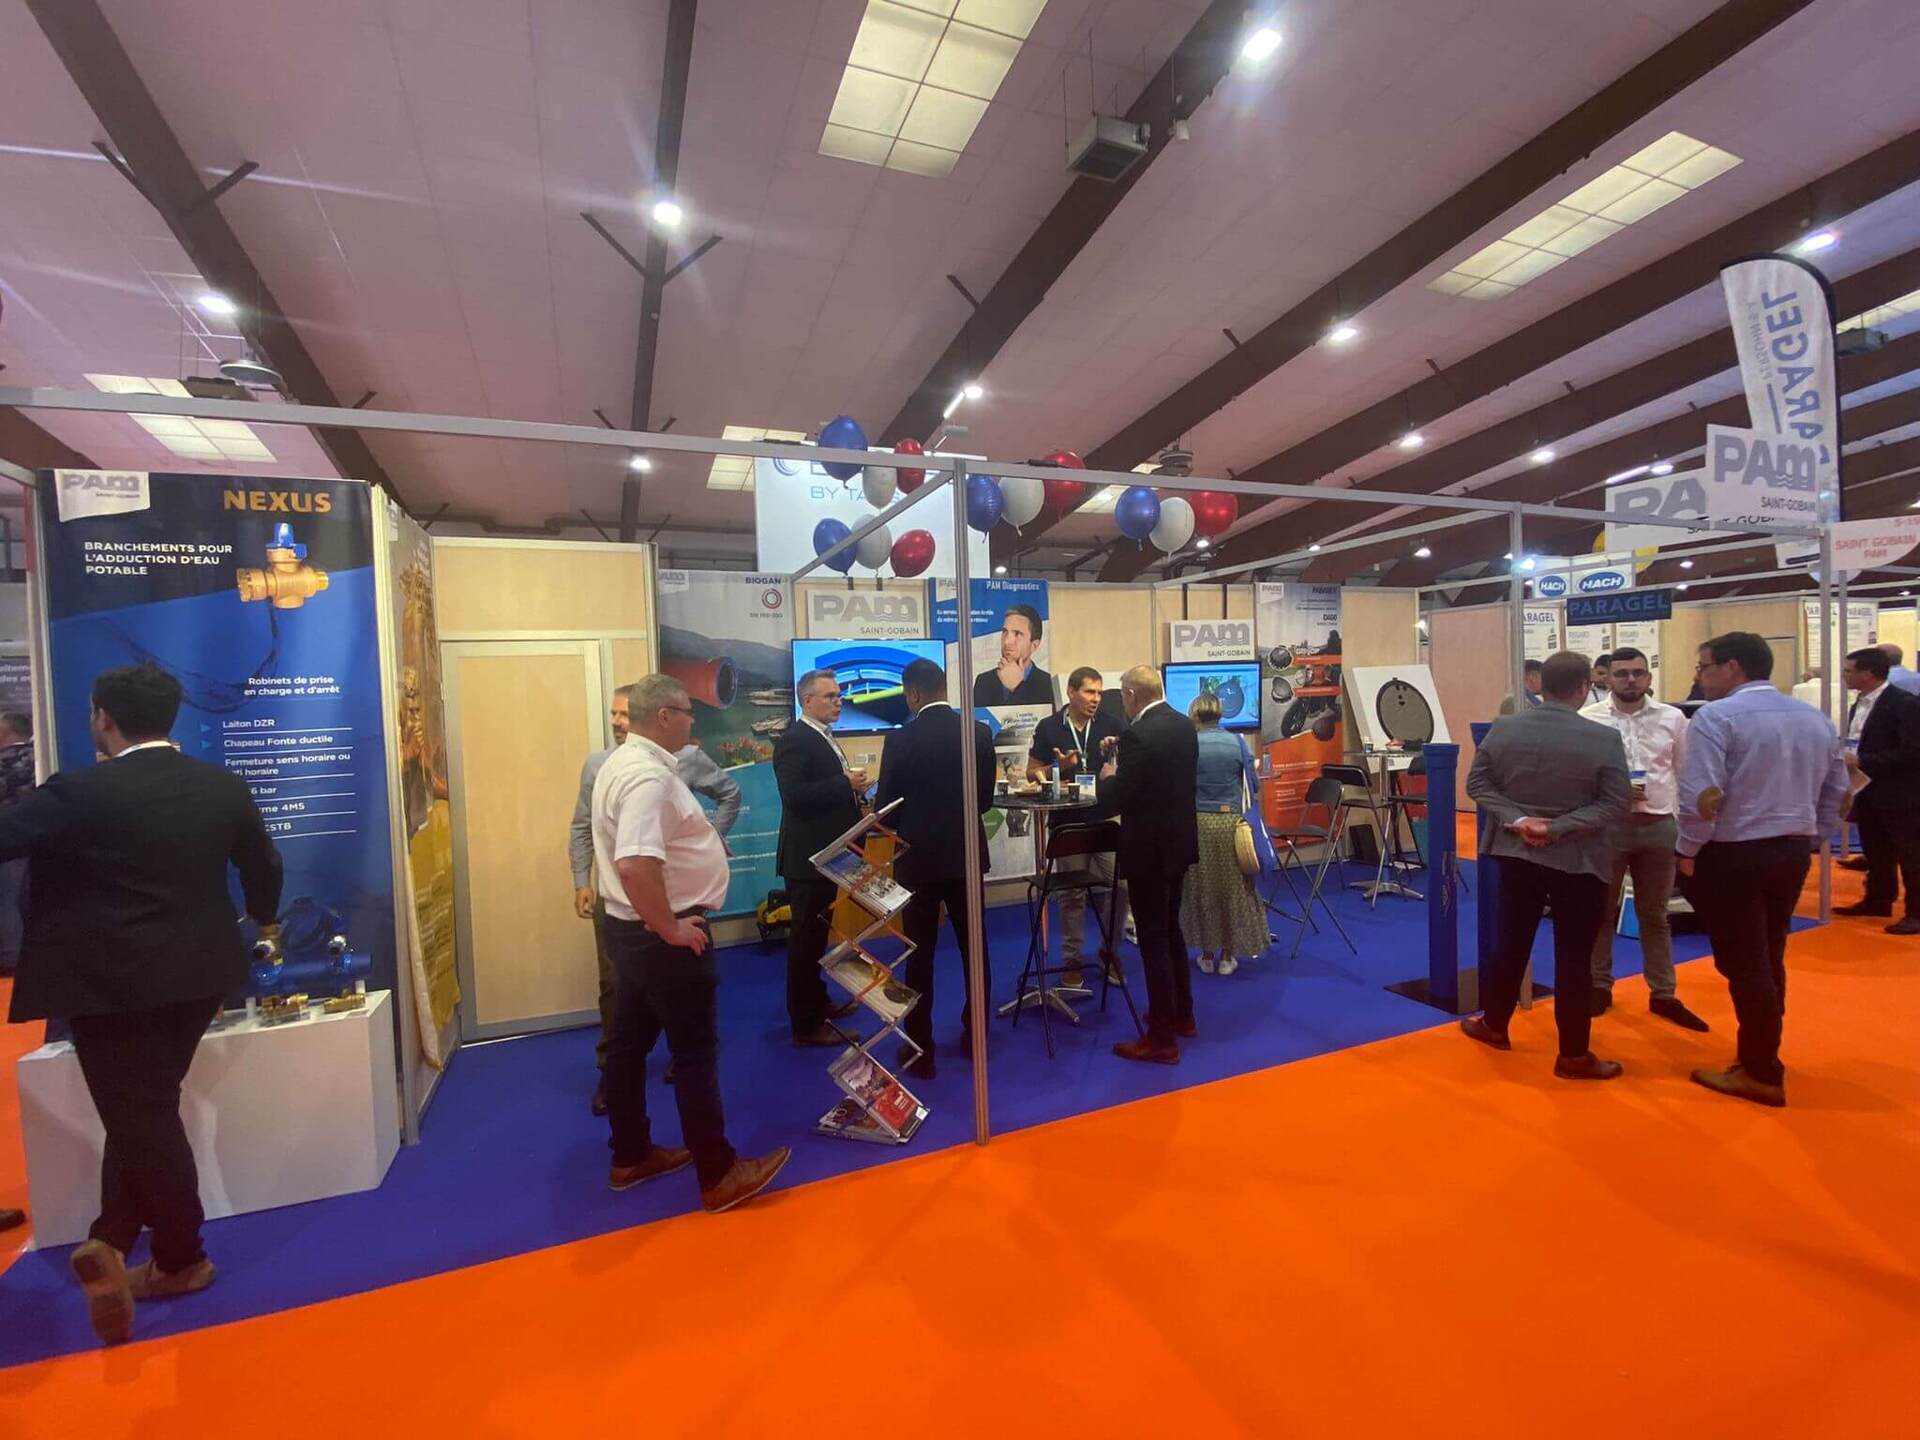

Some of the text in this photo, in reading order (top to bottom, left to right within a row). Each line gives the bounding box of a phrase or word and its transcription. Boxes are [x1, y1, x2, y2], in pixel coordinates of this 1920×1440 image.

[811, 487, 838, 499] BY
[223, 490, 332, 512] NEXUS
[84, 542, 232, 554] BRANCHEMENTS POUR
[1835, 534, 1917, 551] SAINT GOBAIN
[85, 554, 220, 565] L'ADDUCTION D'EAU
[86, 566, 148, 575] POTABLE
[1002, 581, 1040, 592] Diagnostics
[1540, 580, 1565, 590] HACH
[1582, 577, 1621, 588] HACH
[1569, 594, 1669, 616] PARAGEL
[248, 676, 334, 686] Robinets de prise
[258, 687, 291, 697] charge
[307, 685, 340, 694] d'arrêt
[223, 719, 275, 729] Laiton DZR
[224, 735, 333, 748] Chapeau Fonte ductile
[225, 753, 351, 767] Fermeture sens horaire ou
[245, 767, 279, 777] horaire
[260, 786, 277, 794] bar
[281, 802, 305, 811] 4MS
